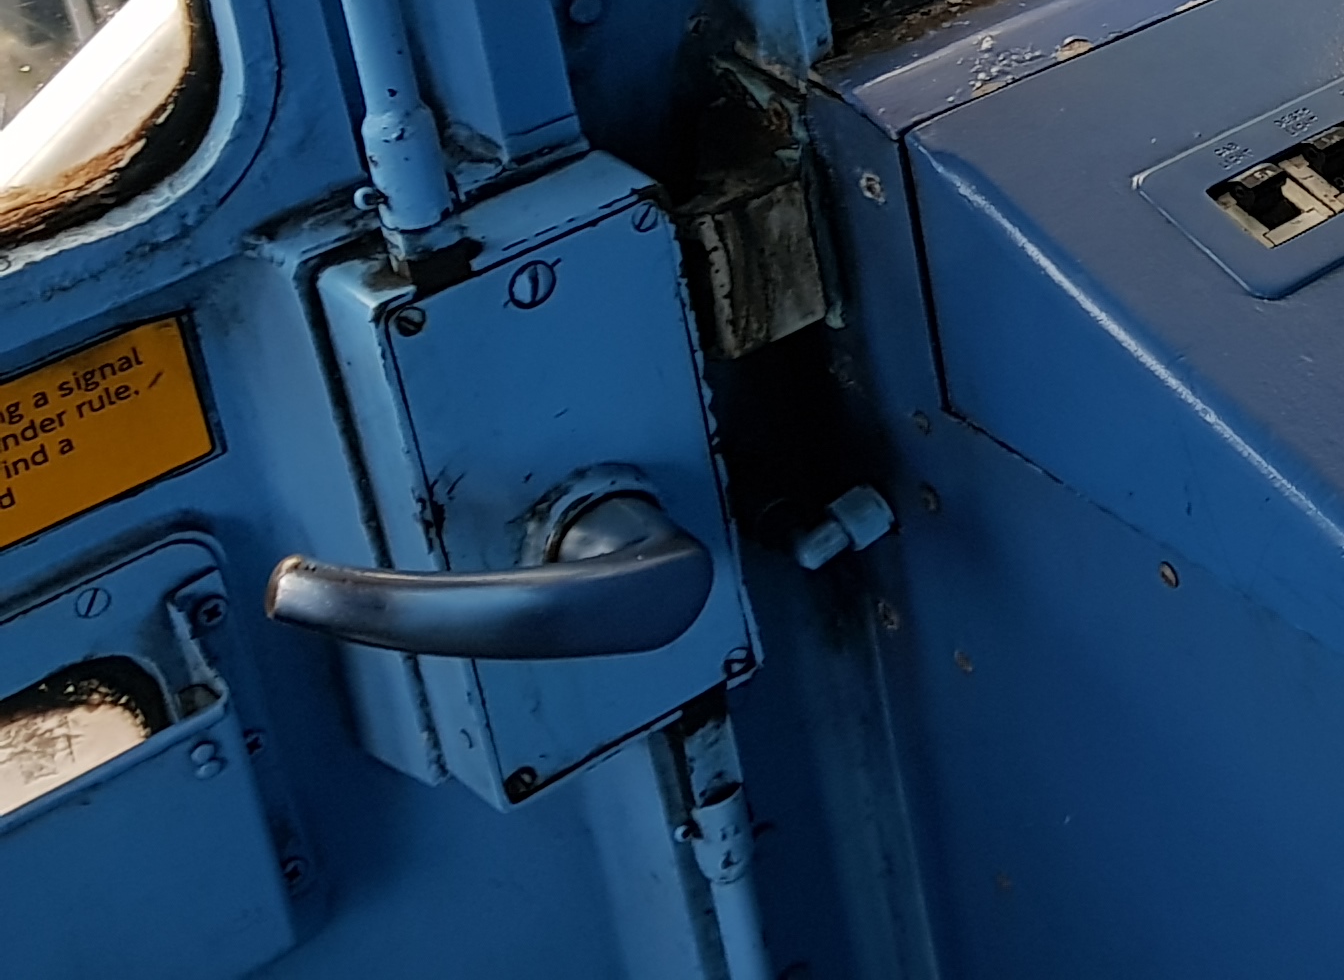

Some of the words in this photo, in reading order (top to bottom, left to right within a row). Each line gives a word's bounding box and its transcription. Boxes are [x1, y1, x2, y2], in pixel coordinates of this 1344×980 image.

[32, 391, 49, 409] a
[57, 346, 144, 398] signal
[0, 408, 68, 452] nder
[75, 382, 141, 420] rule.
[58, 438, 75, 455] a
